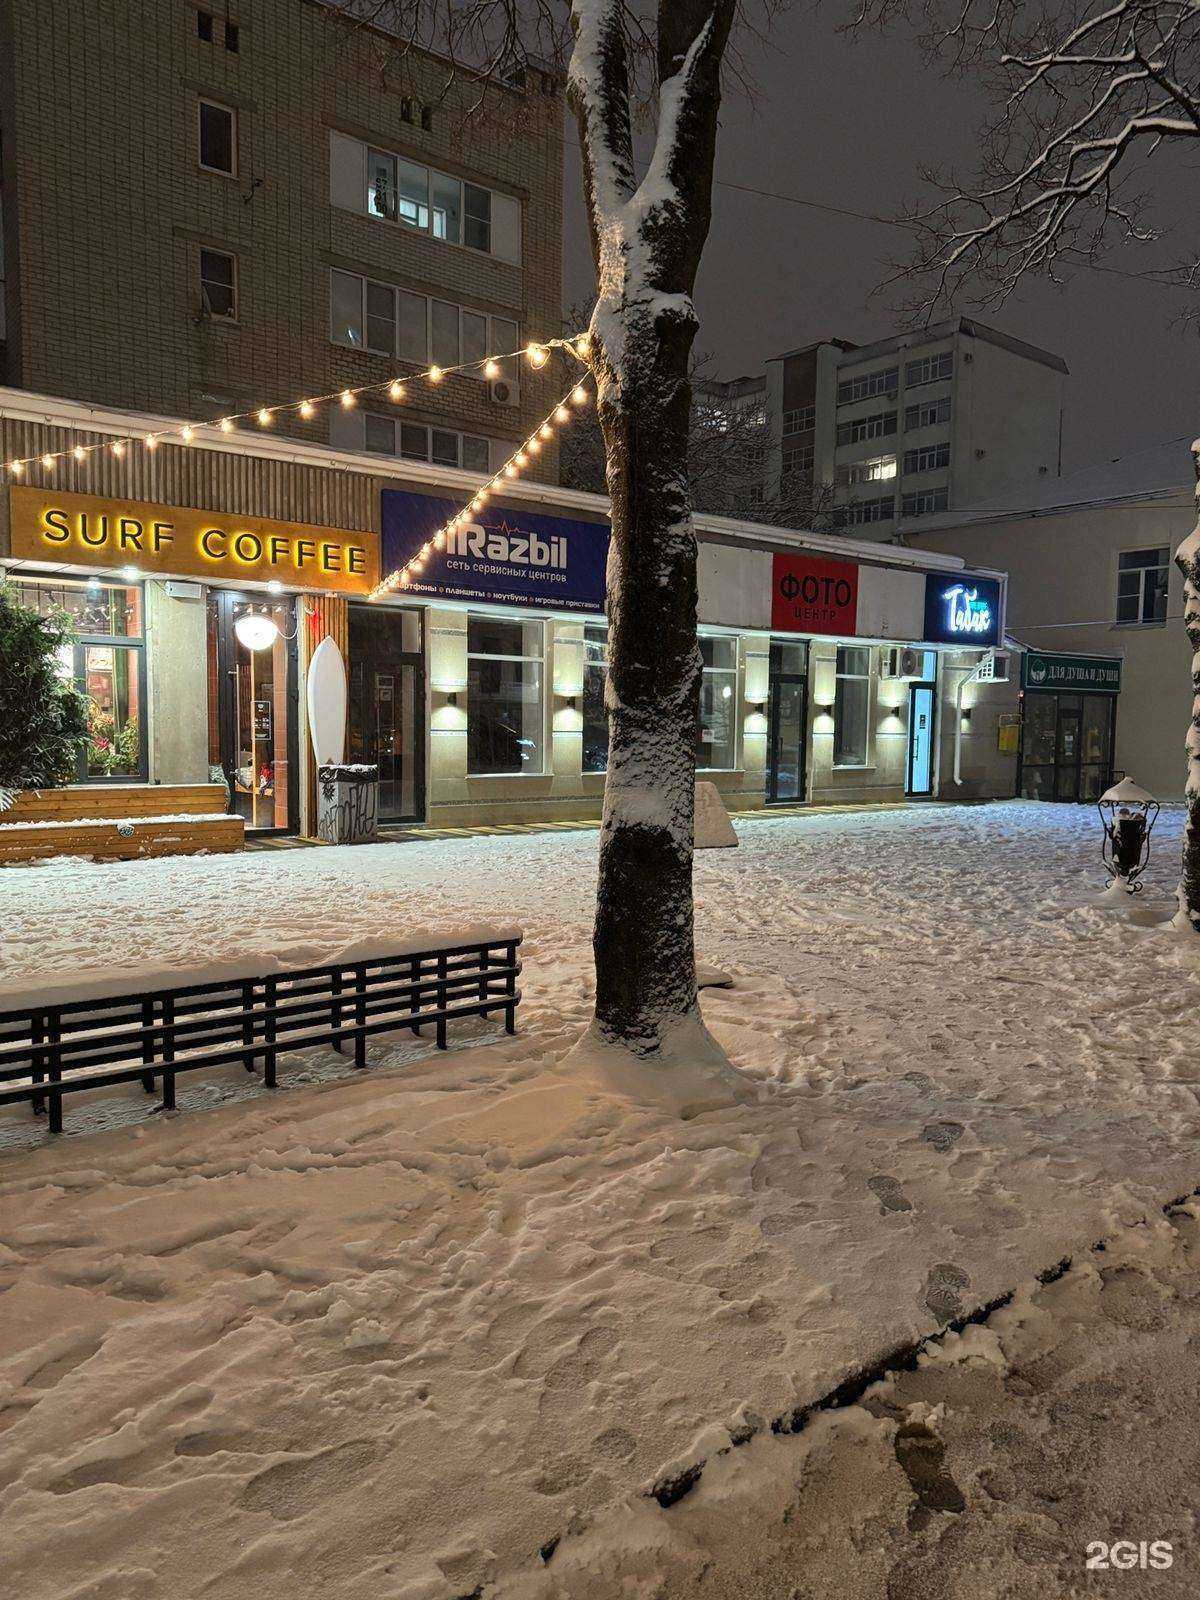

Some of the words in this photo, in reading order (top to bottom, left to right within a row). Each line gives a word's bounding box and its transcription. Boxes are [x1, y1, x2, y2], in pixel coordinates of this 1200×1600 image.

[44, 509, 174, 552] SURF
[201, 529, 366, 574] COFFEE
[446, 559, 470, 571] сеть
[472, 562, 527, 578] сервисных
[528, 569, 567, 583] центров
[445, 586, 486, 598] планшеты
[492, 592, 528, 603] ноутбуки
[779, 573, 852, 608] ФОТО
[793, 608, 837, 622] ЦЕНТР
